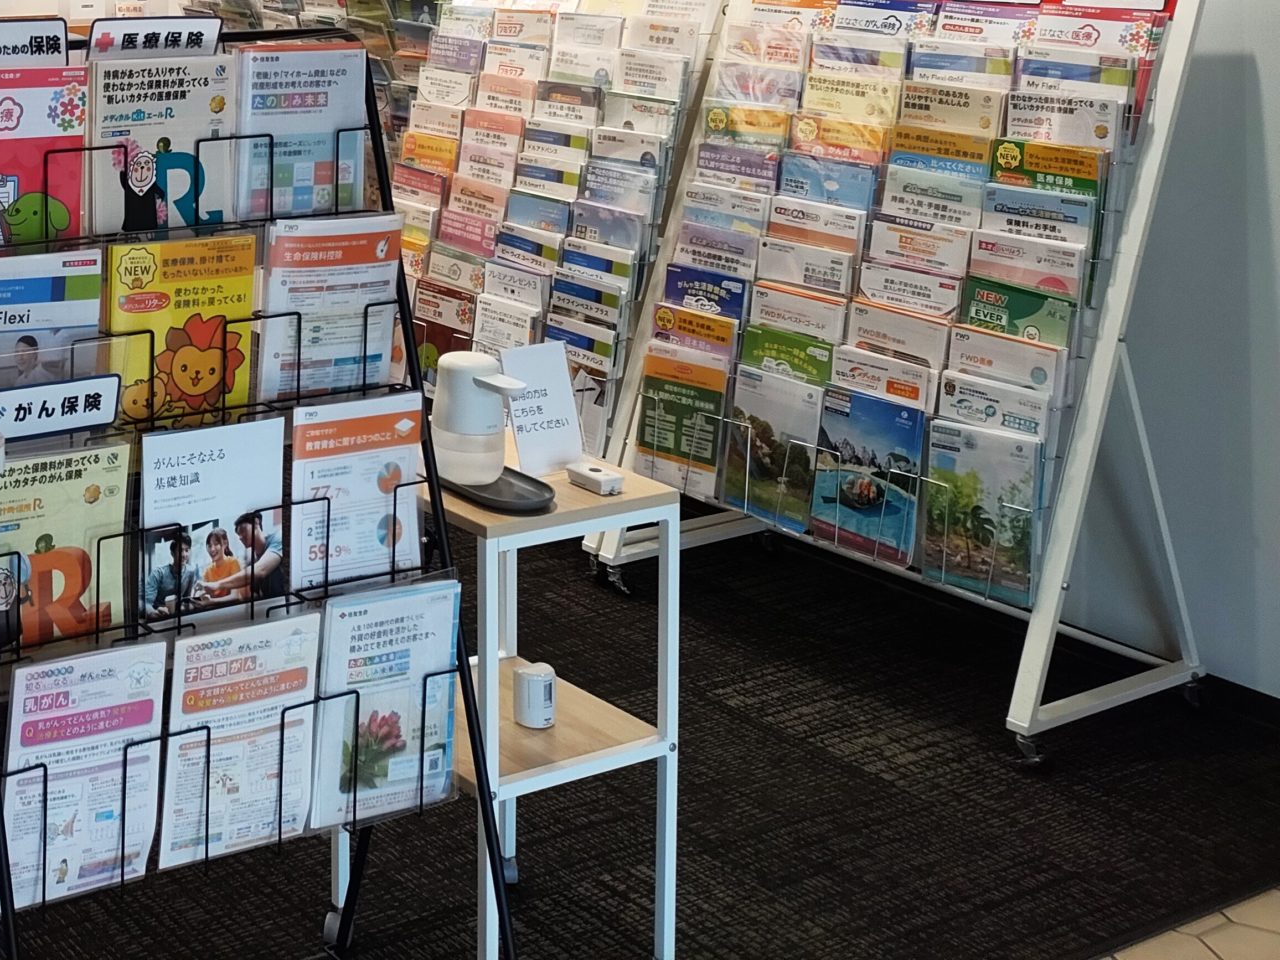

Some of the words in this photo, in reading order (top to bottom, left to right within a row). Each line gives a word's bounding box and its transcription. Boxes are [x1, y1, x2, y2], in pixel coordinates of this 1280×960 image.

[121, 31, 204, 50] 医療保険
[103, 77, 209, 93] 使わなかった保険料が戻ってくる
[1027, 80, 1040, 90] My
[1042, 81, 1060, 91] Flexi
[253, 93, 327, 107] たのしみ未来
[102, 113, 131, 123] メディカル
[1000, 153, 1018, 161] NEW
[1036, 173, 1073, 186] 医療保険
[124, 265, 151, 277] NEW
[174, 285, 224, 297] 使わなかった
[174, 294, 246, 309] 保険料が戻ってくる!
[976, 291, 1008, 306] NEW
[975, 308, 1003, 323] EVER
[955, 332, 969, 340] FWD
[960, 353, 993, 366] FWD医療
[14, 391, 102, 422] がん保険
[513, 405, 544, 418] こちらを
[516, 418, 569, 434] 押してください
[153, 449, 226, 470] がんにそなえる
[154, 473, 200, 490] 基礎知識
[307, 528, 313, 536] 2
[25, 692, 67, 712] 乳がん
[187, 696, 194, 705] Q
[26, 727, 34, 737] Q
